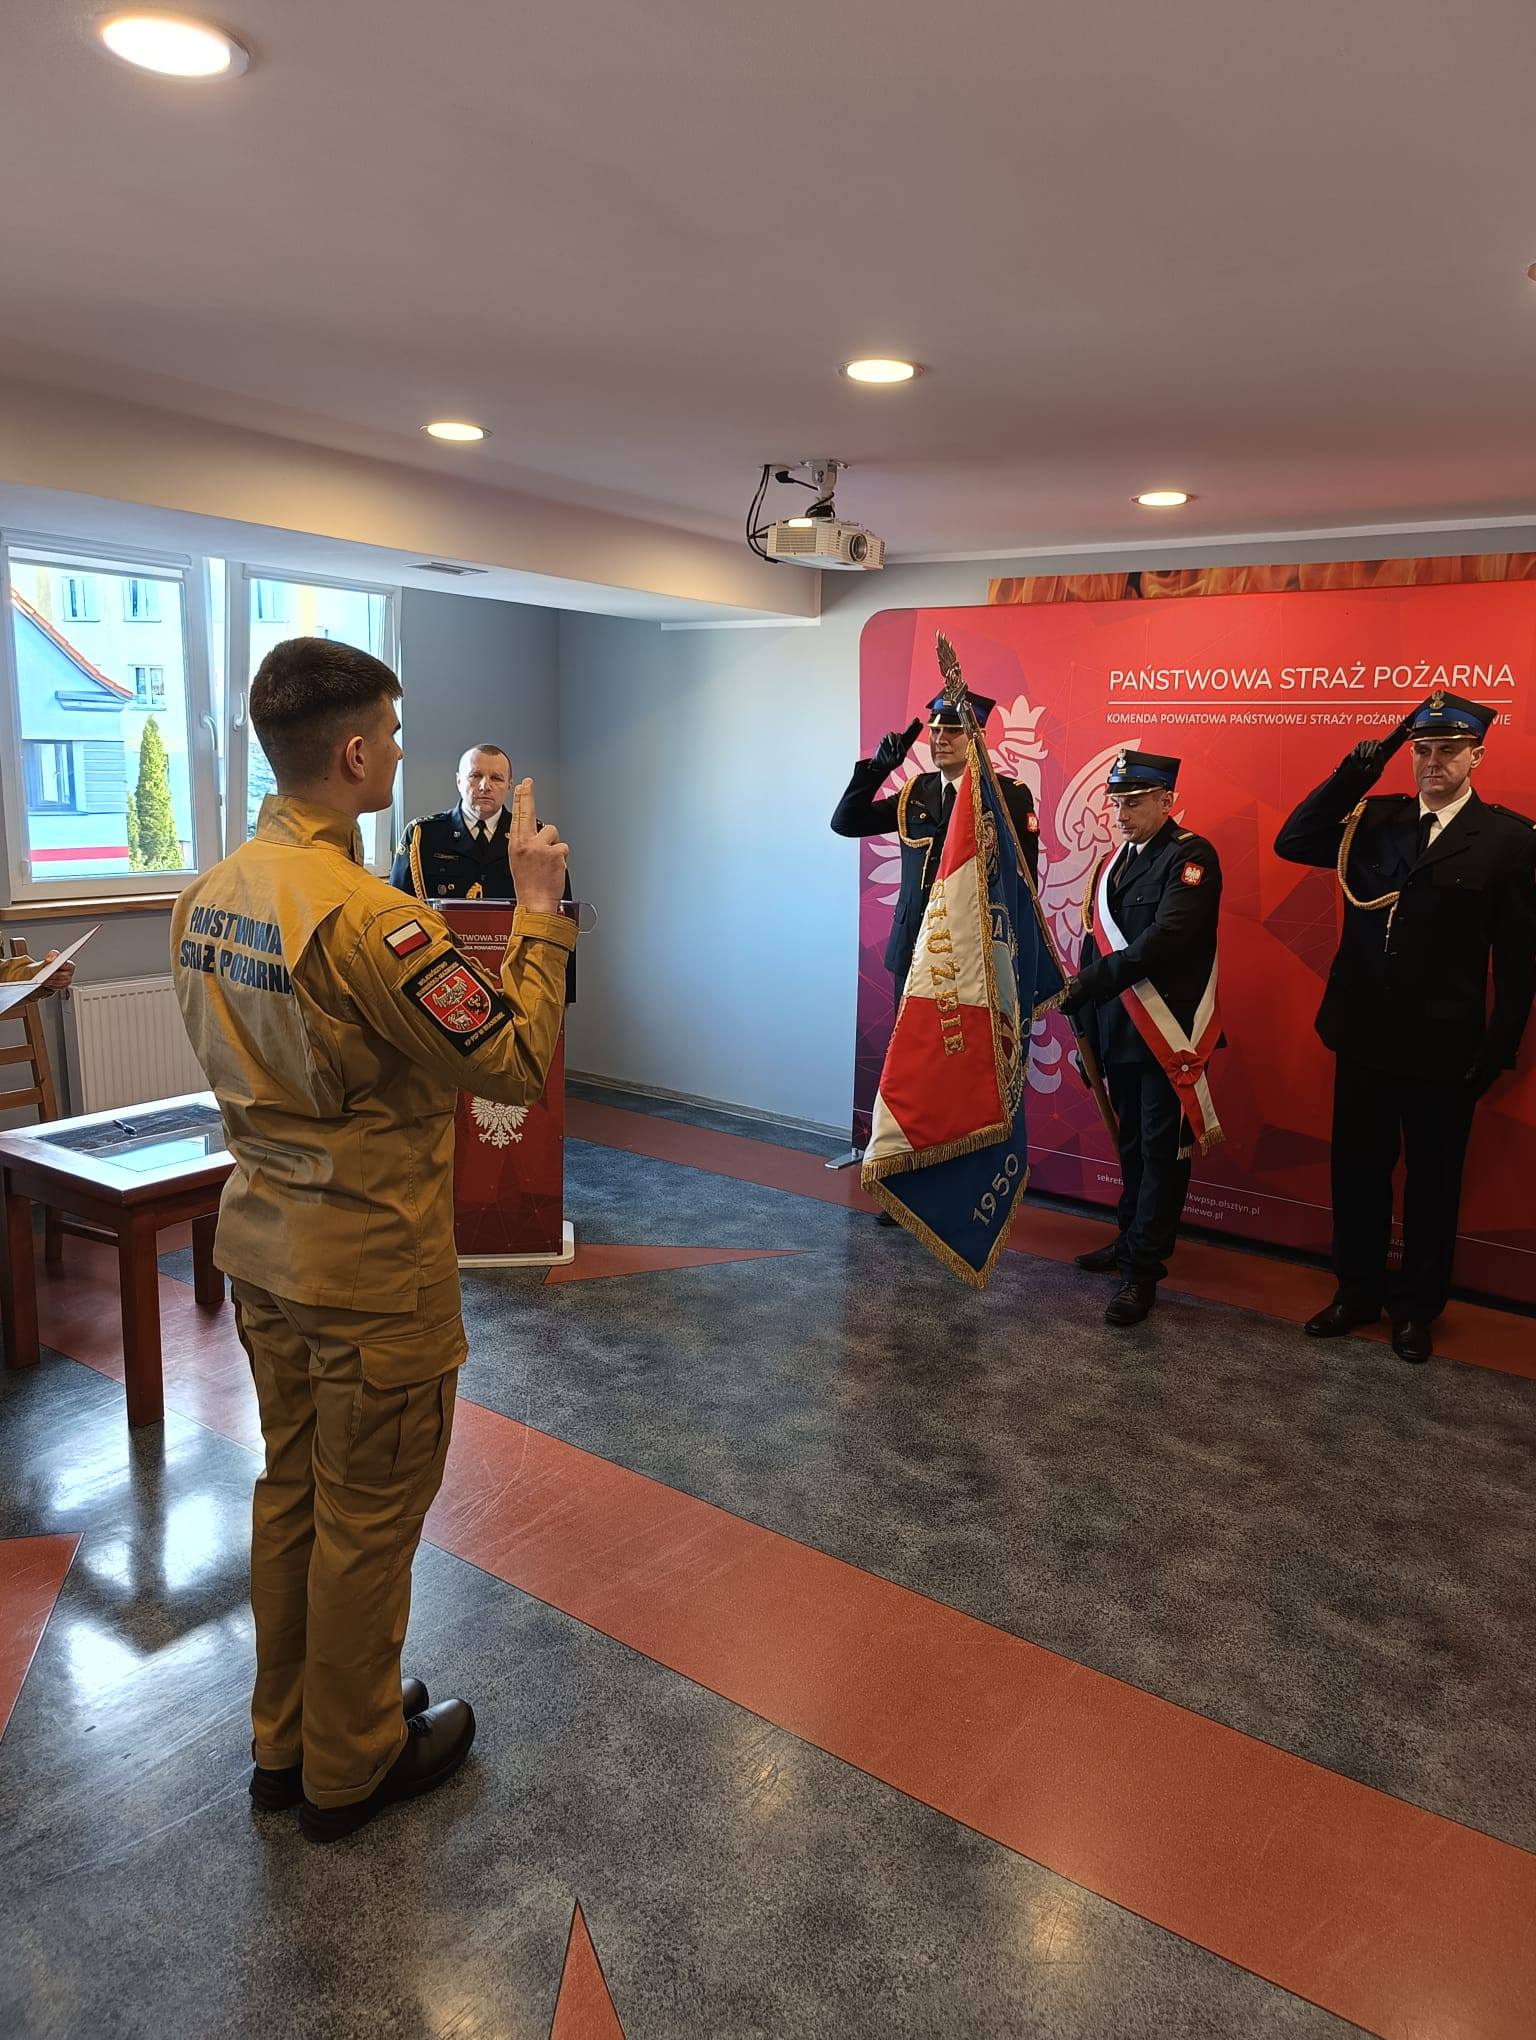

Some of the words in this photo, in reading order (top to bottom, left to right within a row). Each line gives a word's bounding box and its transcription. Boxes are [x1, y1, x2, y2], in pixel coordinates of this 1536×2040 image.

[1109, 664, 1273, 691] PAŃSTWOWA
[1279, 660, 1367, 690] STRAŻ
[1373, 659, 1516, 688] POŻARNA
[1106, 712, 1158, 725] KOMENDA
[1160, 713, 1227, 725] POWIATOWA
[1229, 711, 1307, 726] PAŃSTWOWEJ
[1310, 711, 1352, 726] STRAŻY
[1355, 711, 1409, 726] POŻARN
[189, 904, 282, 956] PAŃSTWOWA
[972, 1152, 1019, 1227] 1950
[1182, 1205, 1224, 1221] aniewo.pl
[1185, 1192, 1261, 1216] kwpsp.olsztyn.pl
